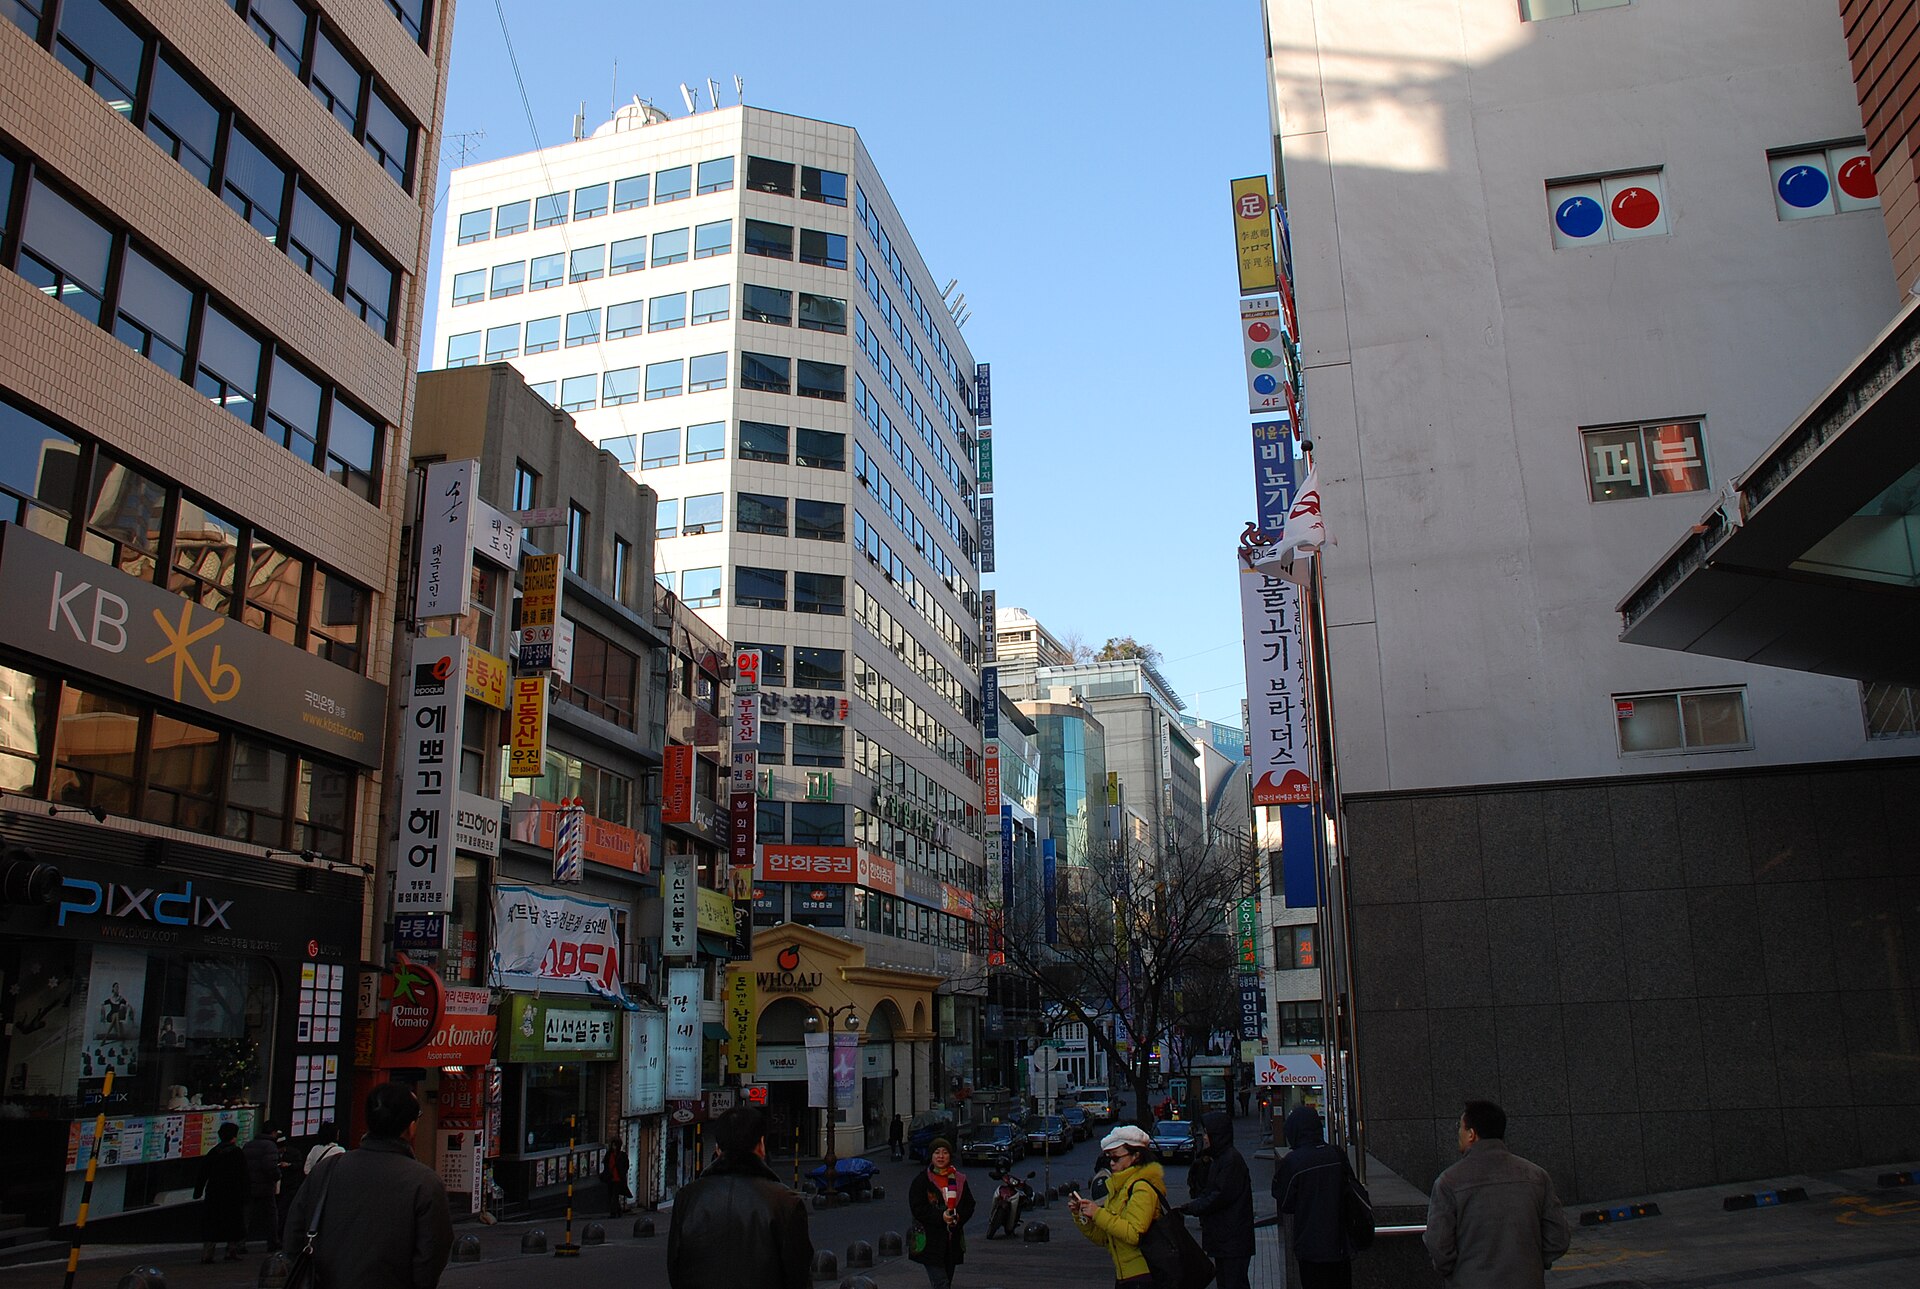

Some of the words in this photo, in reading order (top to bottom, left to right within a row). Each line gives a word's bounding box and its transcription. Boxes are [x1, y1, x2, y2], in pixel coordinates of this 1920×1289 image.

[1241, 195, 1262, 218] 足
[1241, 243, 1270, 255] アロマ
[1261, 397, 1280, 408] 4F
[1254, 424, 1291, 441] 이윤수
[1592, 436, 1702, 488] 피부
[1259, 441, 1291, 531] 비뇨기과
[525, 556, 557, 573] MONEY
[524, 574, 556, 591] EXCHANGE
[524, 594, 554, 607] 환전
[49, 570, 130, 654] KB
[1256, 574, 1292, 672] 불고기
[520, 644, 552, 660] 779-5954
[466, 656, 504, 694] 부동산
[737, 653, 759, 684] 약
[415, 686, 444, 695] epoque
[304, 689, 335, 714] 국민은행
[335, 705, 346, 719] 명동
[515, 681, 540, 747] 부동산
[303, 711, 365, 743] www.kbstar.com
[738, 699, 755, 741] 부동산
[1266, 677, 1296, 765] 브라더스
[511, 749, 539, 764] 우진
[986, 767, 998, 806] 한화증권
[595, 826, 631, 855] Esthe
[736, 818, 748, 858] 와코루
[988, 839, 1000, 861] 치과
[769, 854, 852, 873] 한화증권
[869, 862, 893, 885] 한화증권
[411, 880, 431, 890] 명동점
[671, 878, 685, 947] 신선설농탕
[802, 901, 833, 909] 한화증권
[398, 919, 441, 940] 부동산
[756, 971, 823, 987] WHO.A.U
[396, 1005, 429, 1016] Omuto
[1242, 991, 1259, 1038] 미인의원
[447, 1023, 495, 1047] tomato
[546, 1018, 614, 1044] 신선설농탕
[427, 1050, 442, 1061] fusion
[1261, 1071, 1277, 1083] SK
[1281, 1073, 1317, 1083] telecom
[441, 1092, 473, 1109] 이발
[749, 1087, 768, 1105] 약
